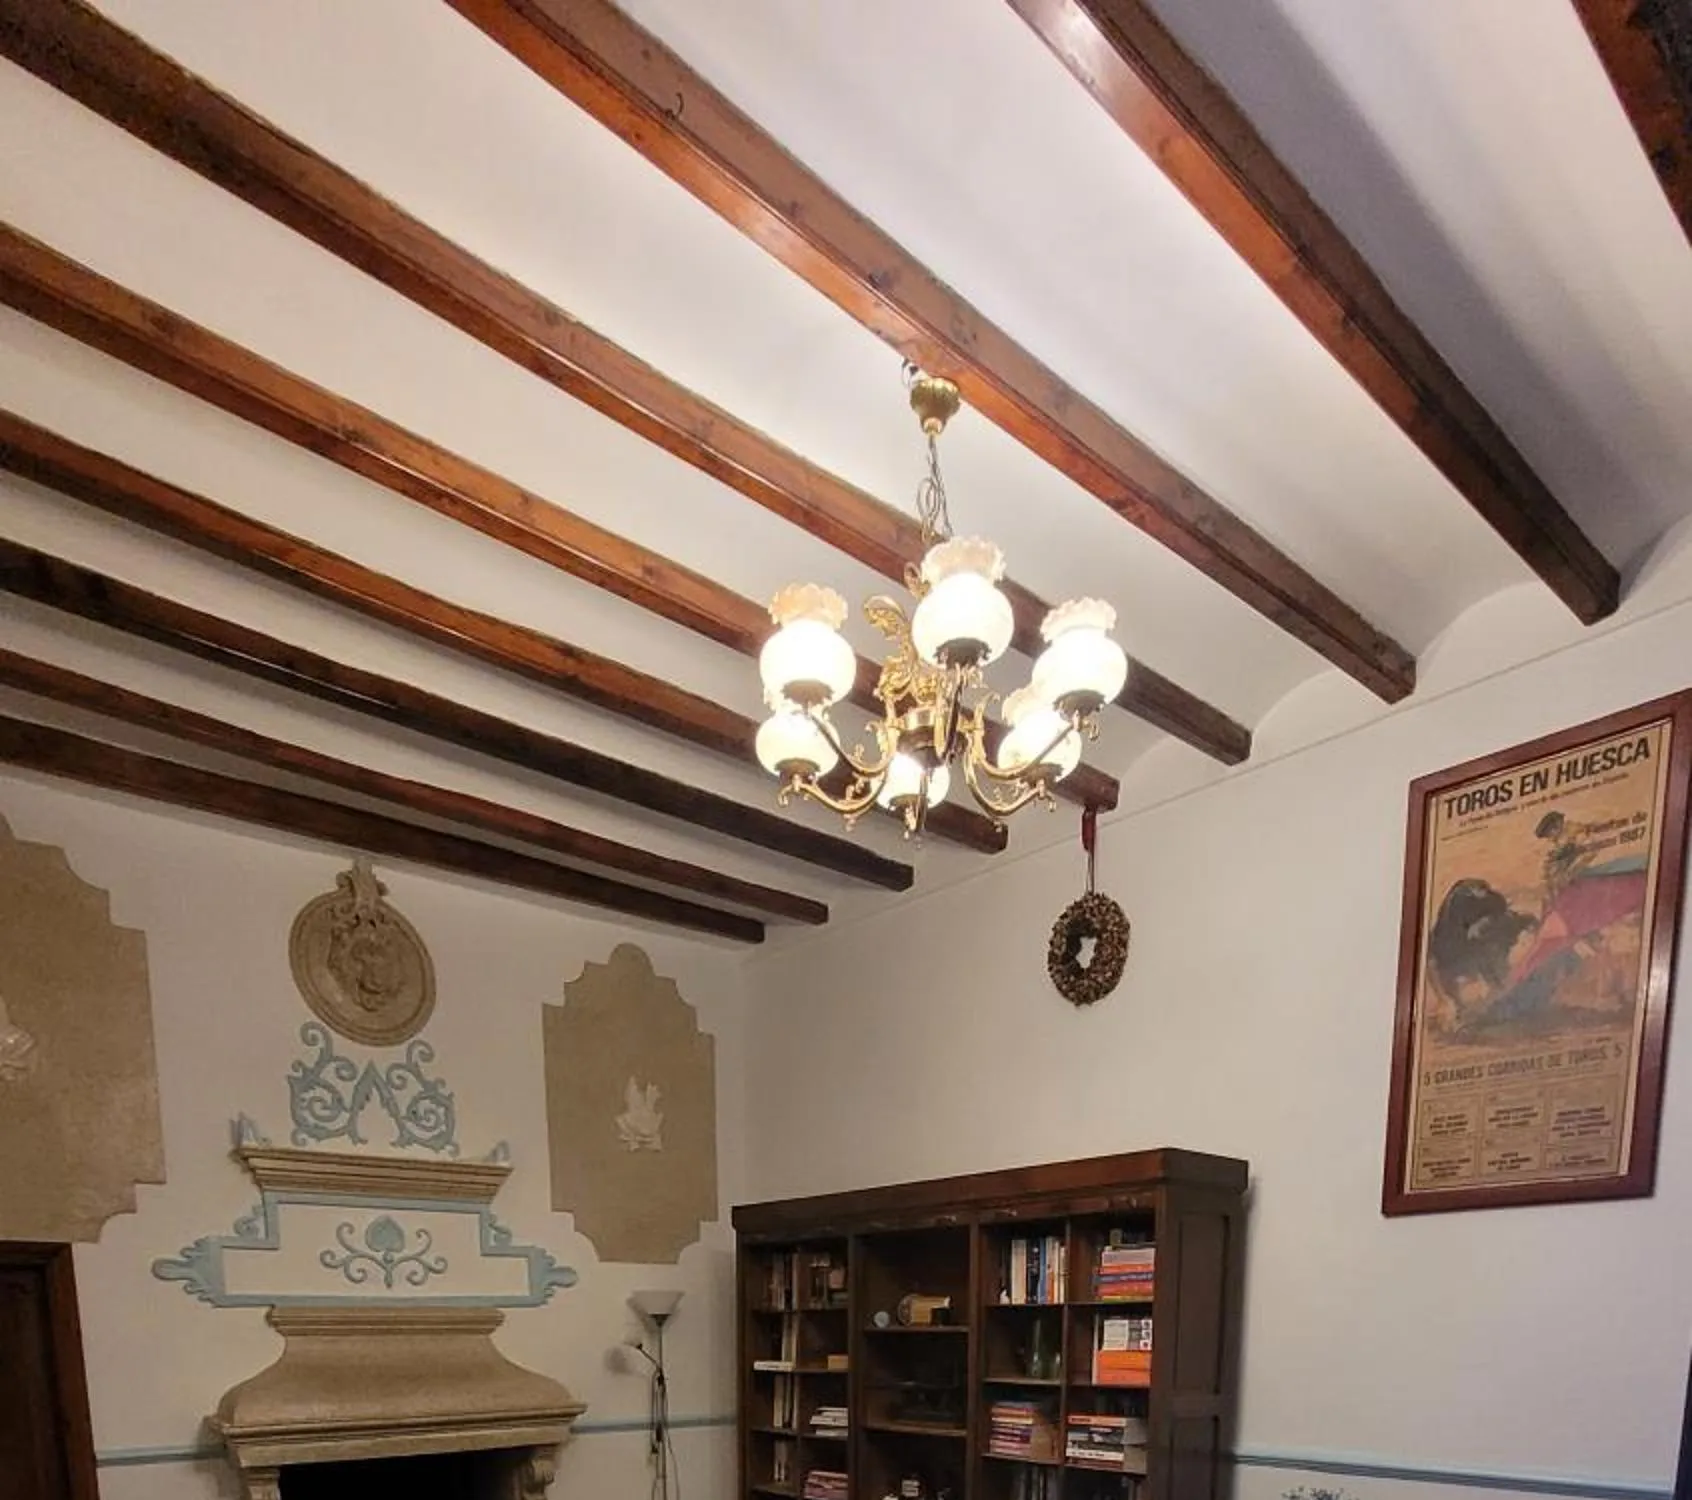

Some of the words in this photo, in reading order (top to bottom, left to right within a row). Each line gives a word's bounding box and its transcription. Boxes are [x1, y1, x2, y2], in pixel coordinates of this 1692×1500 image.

[1444, 779, 1513, 819] TOROS
[1519, 767, 1549, 797] EN
[1555, 737, 1650, 786] HUESCA
[1434, 1065, 1483, 1085] GRANDES
